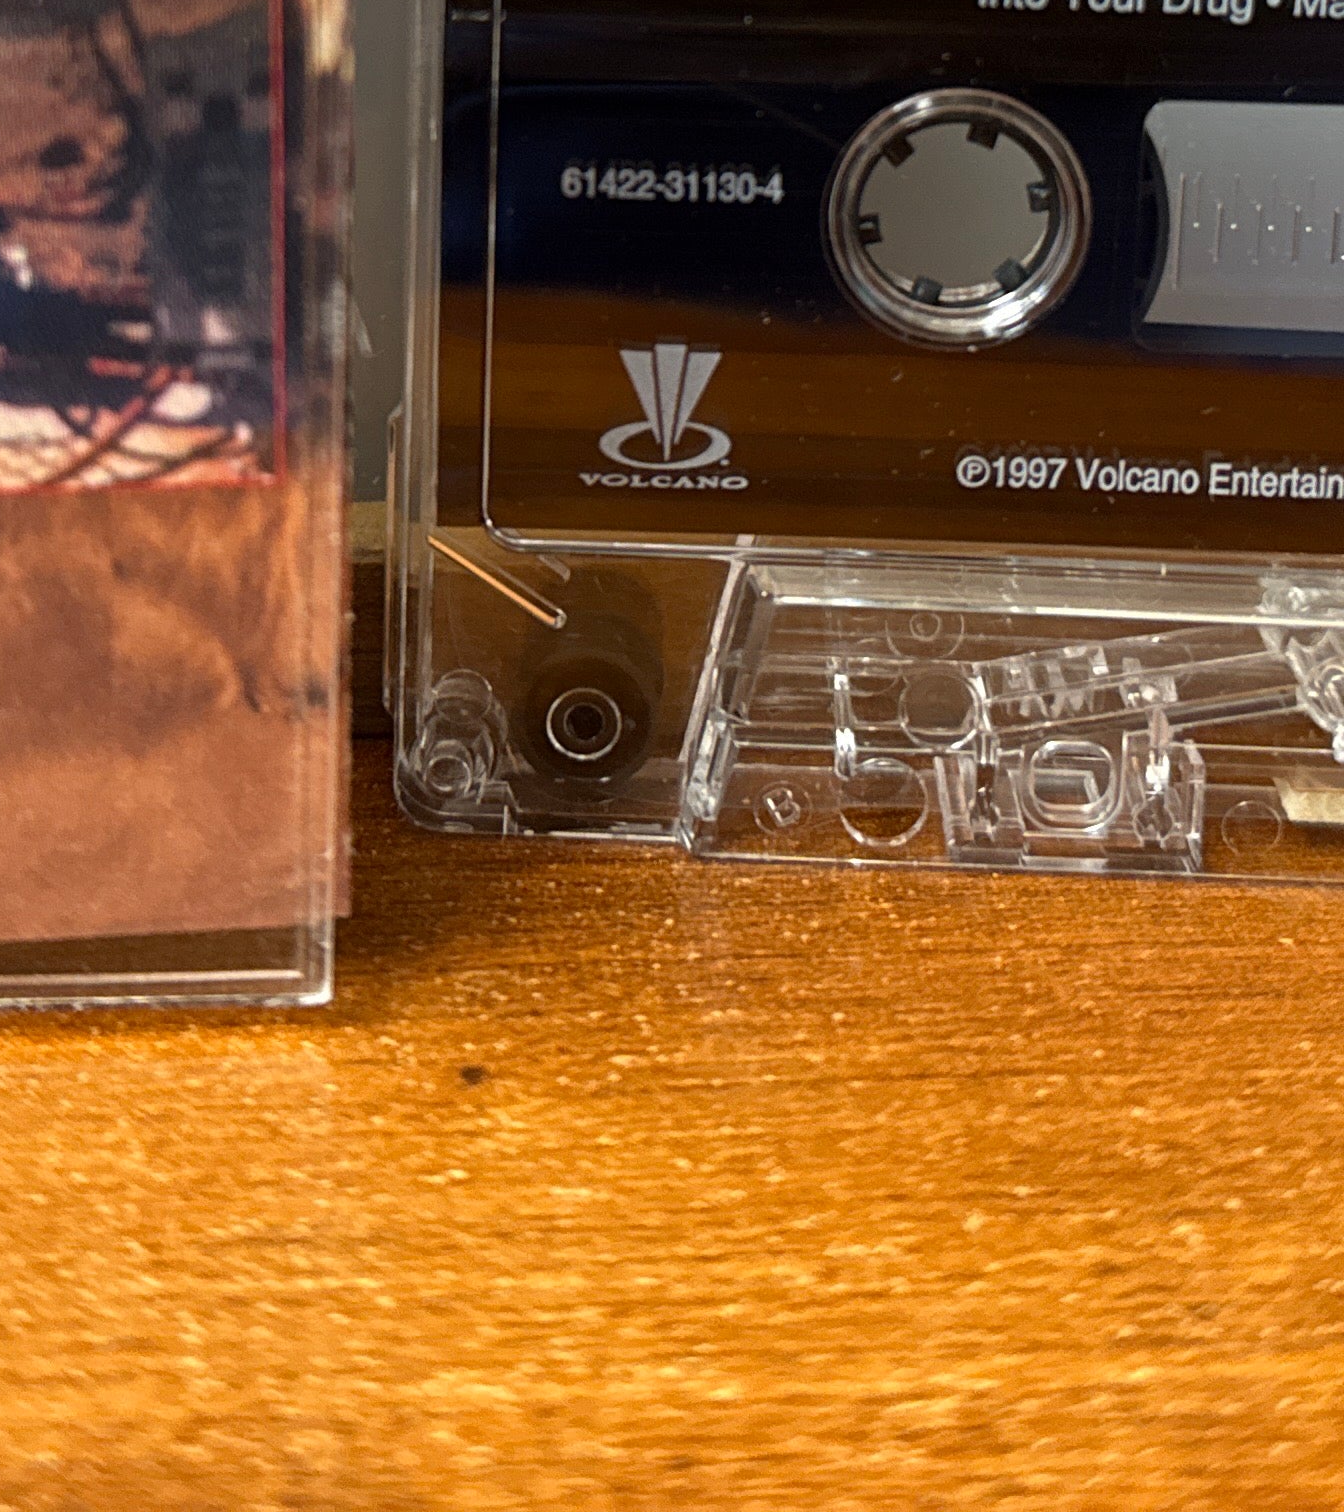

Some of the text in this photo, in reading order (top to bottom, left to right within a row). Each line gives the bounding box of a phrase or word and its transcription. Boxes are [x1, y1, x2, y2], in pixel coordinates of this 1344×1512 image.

[560, 166, 785, 204] 61422-31130-4
[578, 471, 750, 491] VOLCANO
[1075, 458, 1200, 495] Volcano
